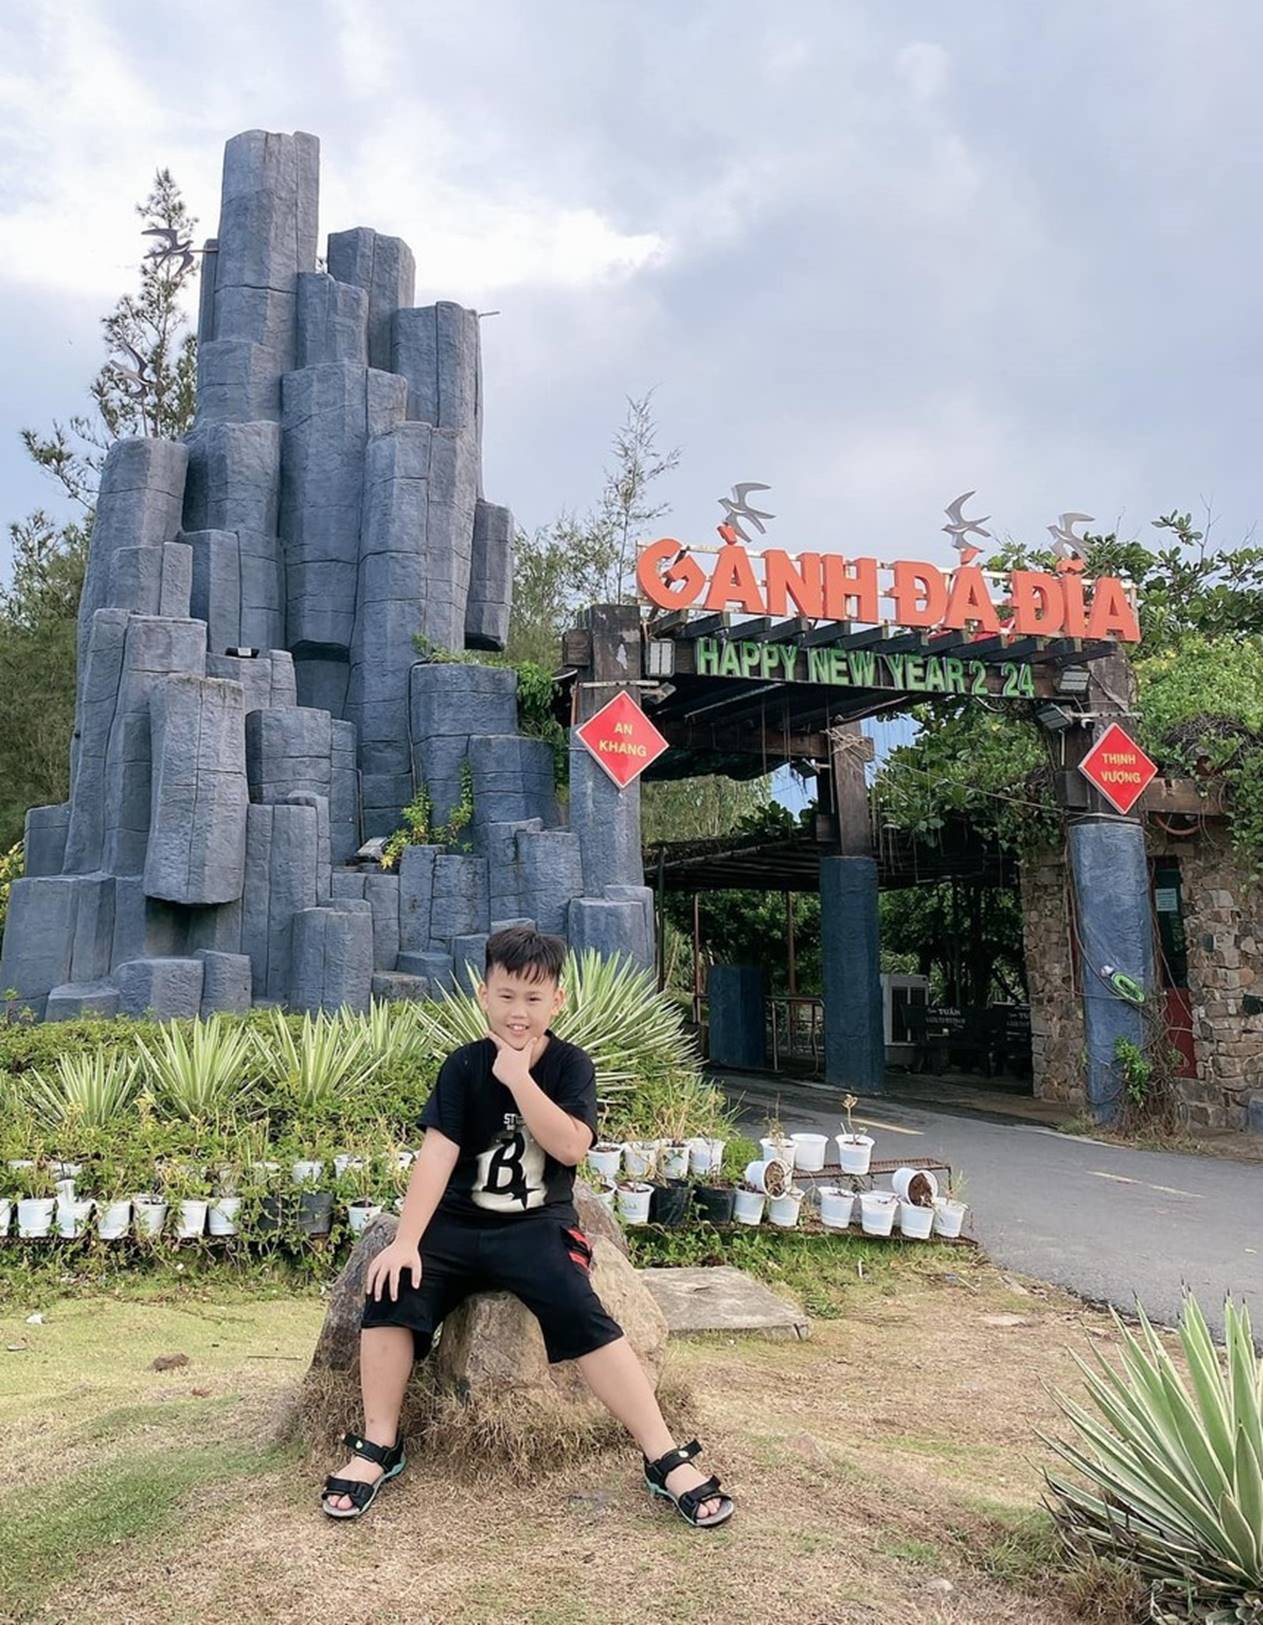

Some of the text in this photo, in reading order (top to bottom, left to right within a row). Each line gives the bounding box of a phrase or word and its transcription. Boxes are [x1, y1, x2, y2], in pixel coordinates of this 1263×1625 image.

[637, 522, 1142, 643] GÀNH ĐÁ ĐĨA
[697, 636, 797, 682] HAPPY
[808, 647, 875, 688] NEW
[884, 652, 966, 693] YEAR
[614, 722, 633, 736] AN
[599, 739, 648, 758] KHANG
[1101, 752, 1137, 766] THỊNH
